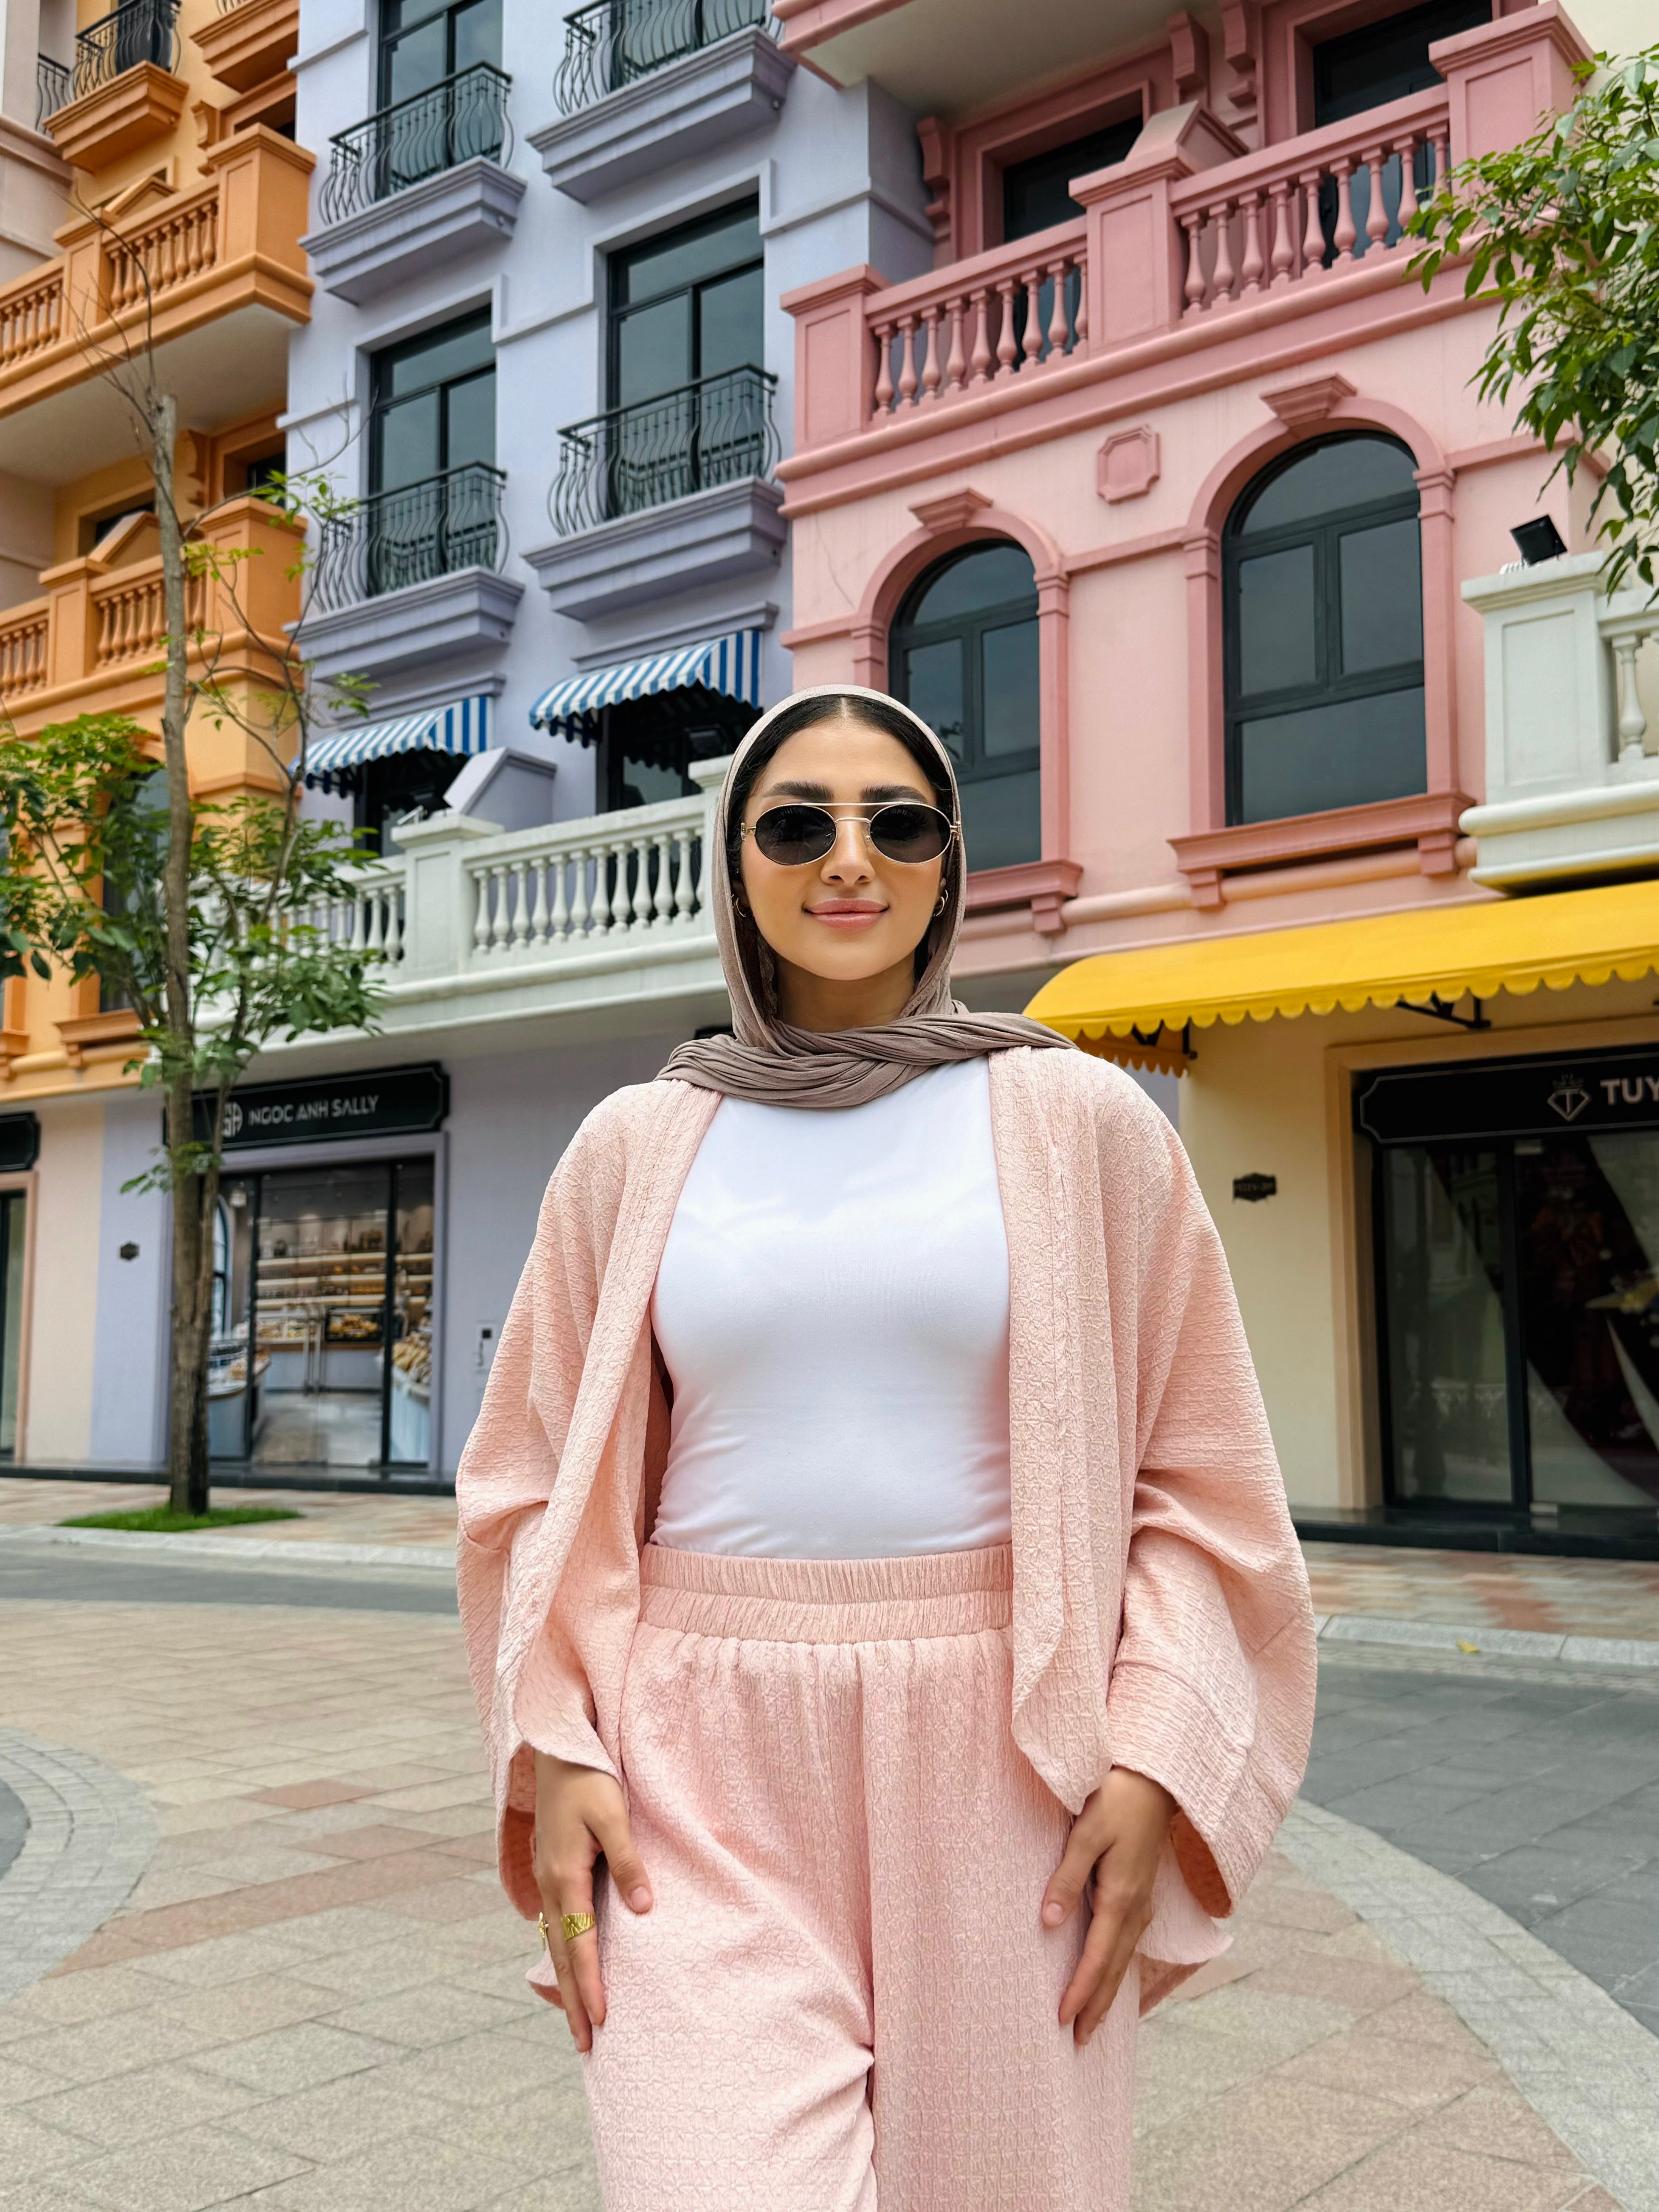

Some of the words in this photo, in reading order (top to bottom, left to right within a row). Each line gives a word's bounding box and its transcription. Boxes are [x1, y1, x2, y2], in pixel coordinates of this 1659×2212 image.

[248, 1104, 294, 1126] NGOC
[296, 1099, 329, 1120] ANH
[331, 1094, 379, 1117] SALLY
